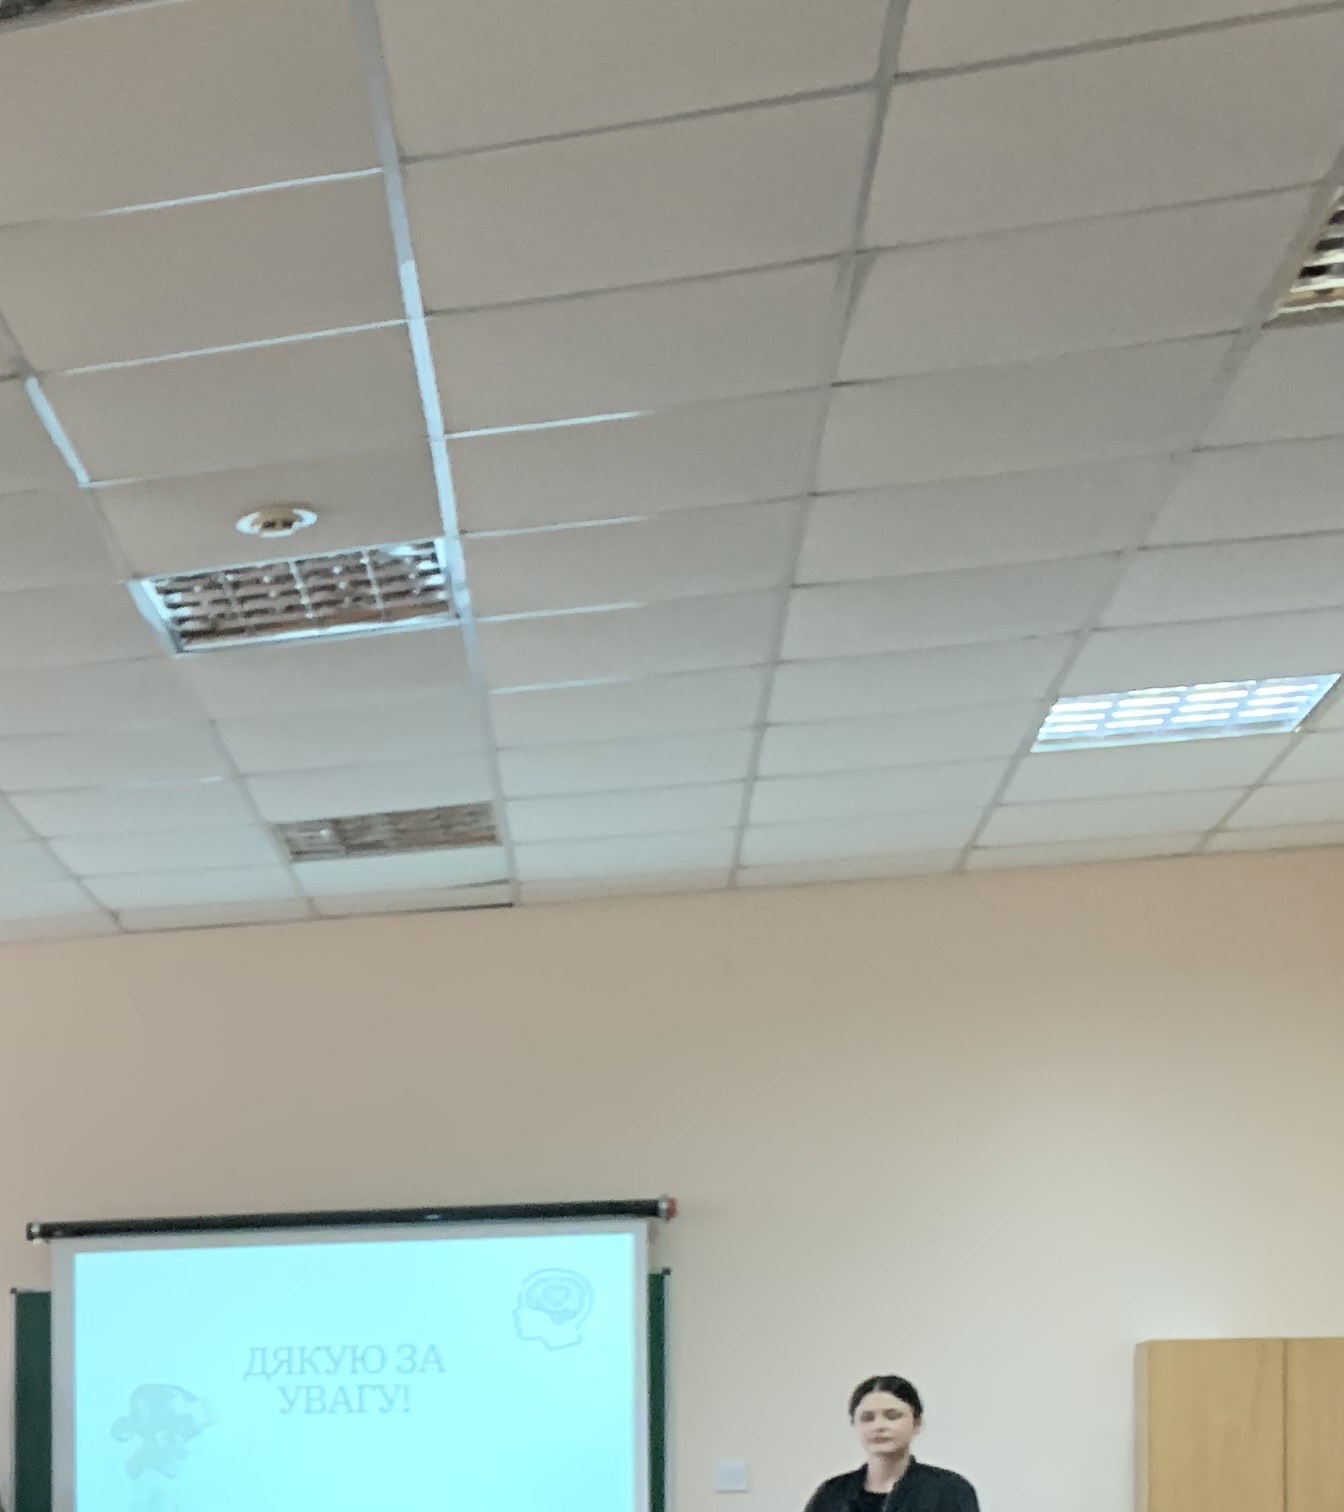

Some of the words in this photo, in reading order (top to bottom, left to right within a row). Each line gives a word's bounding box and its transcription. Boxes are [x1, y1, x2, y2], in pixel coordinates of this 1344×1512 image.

[243, 1346, 387, 1381] ДЯКУЮ
[395, 1343, 446, 1374] ЗА
[277, 1383, 411, 1415] УВАГУ!
